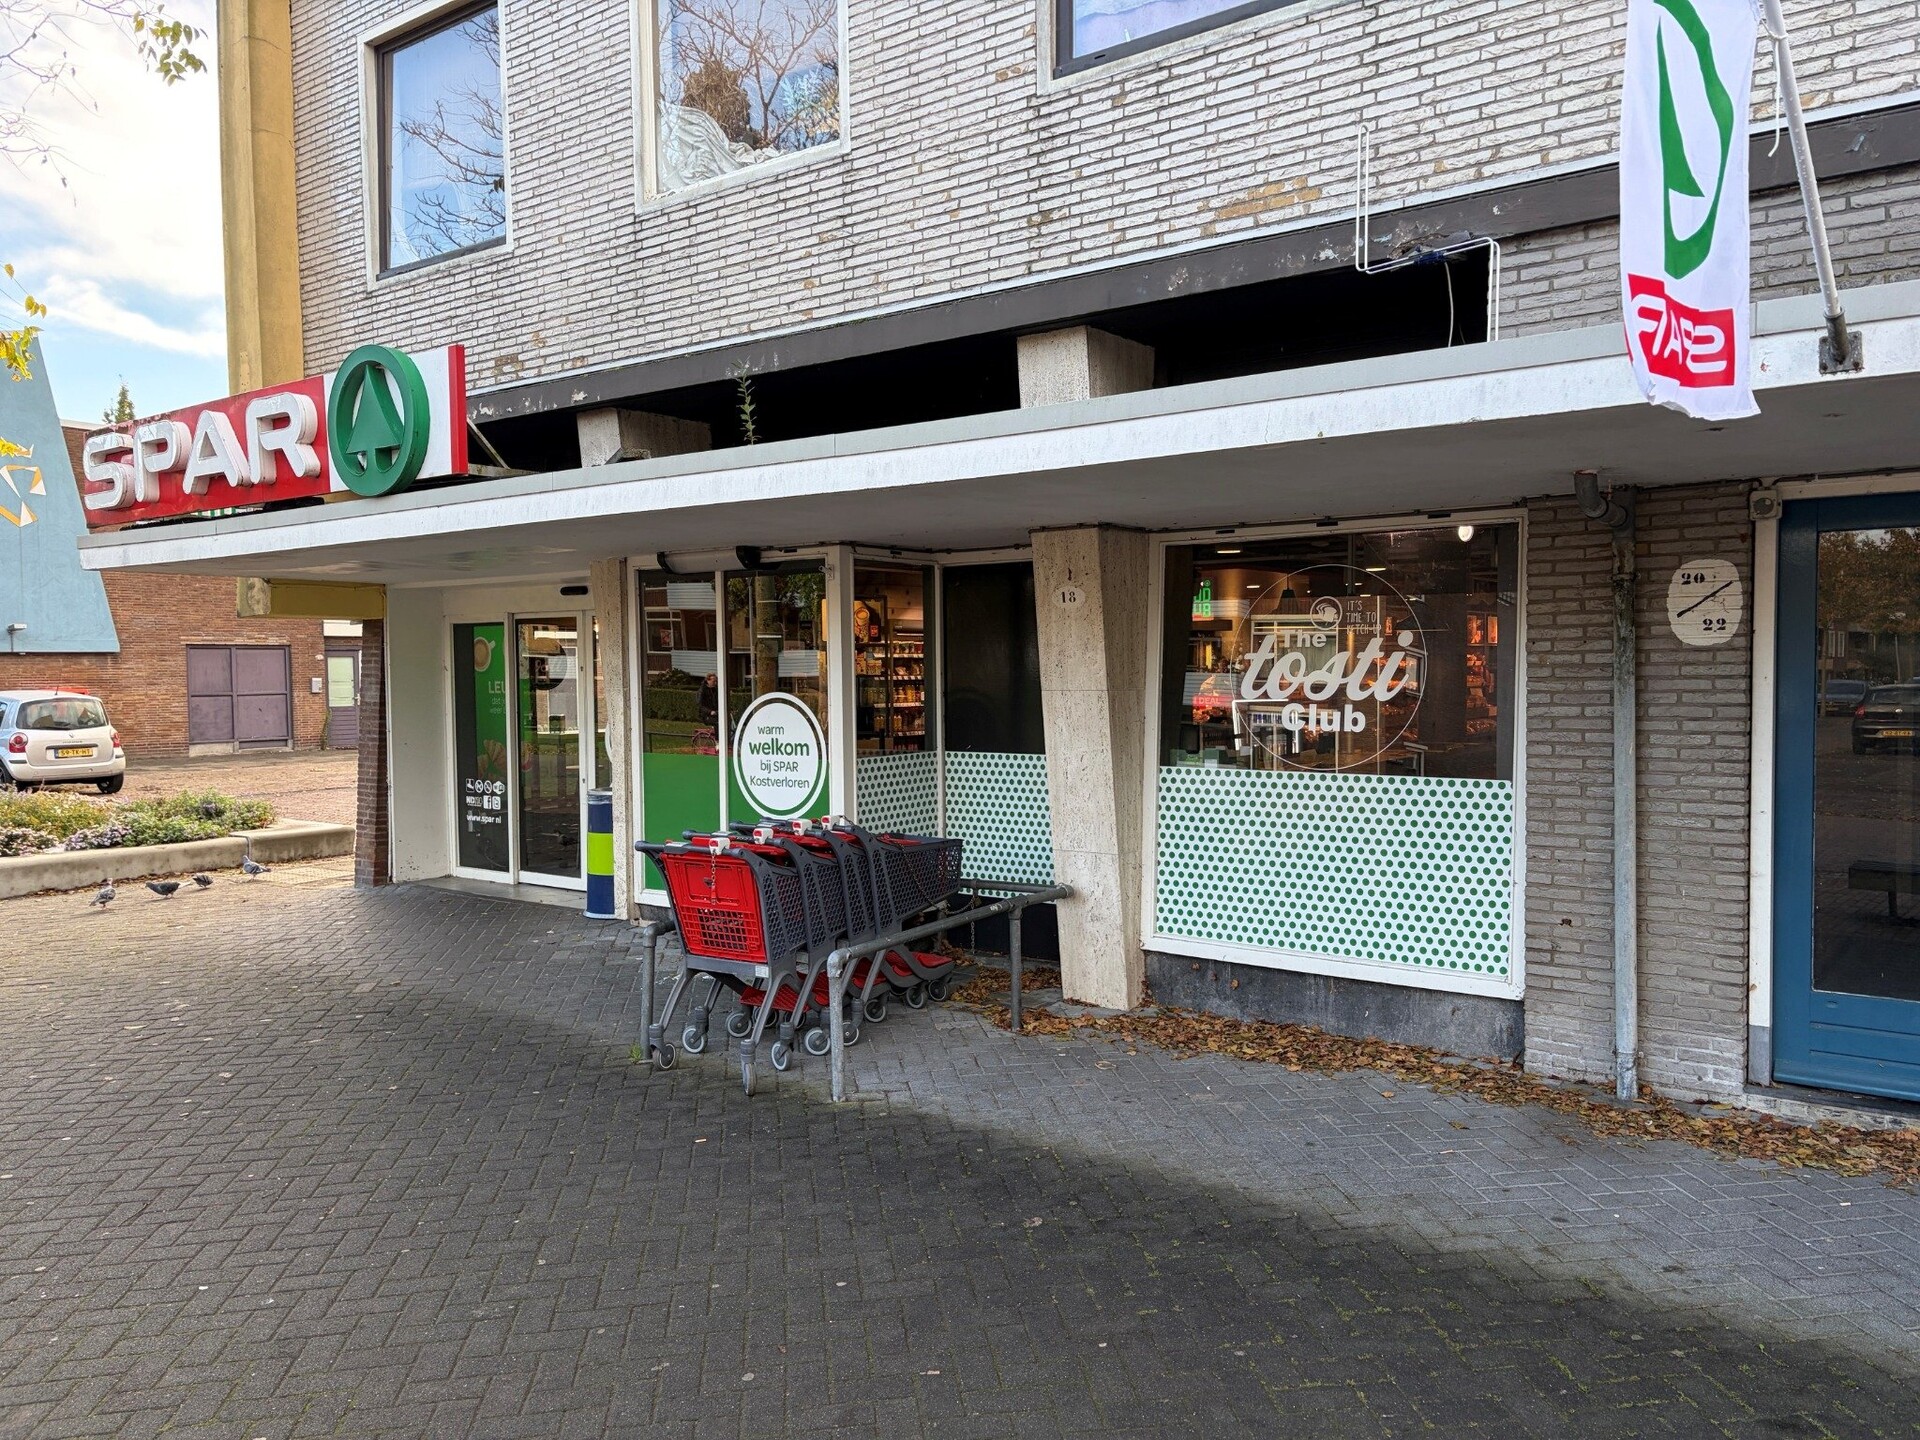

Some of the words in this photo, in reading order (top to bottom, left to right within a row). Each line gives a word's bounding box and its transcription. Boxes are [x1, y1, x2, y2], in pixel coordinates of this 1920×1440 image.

[83, 391, 321, 510] SPAR
[1681, 572, 1706, 585] 20
[1061, 591, 1076, 603] 18
[1345, 612, 1362, 623] TIME
[1366, 611, 1377, 623] TO
[1702, 617, 1727, 631] 22
[1280, 629, 1327, 648] The
[1240, 630, 1414, 702] tosti
[1199, 696, 1221, 705] DEAL
[1281, 703, 1366, 733] Club
[757, 725, 785, 735] warm
[748, 738, 810, 756] welkom
[760, 760, 772, 774] bij
[773, 761, 799, 773] SPAR
[749, 775, 810, 789] Kostverloren
